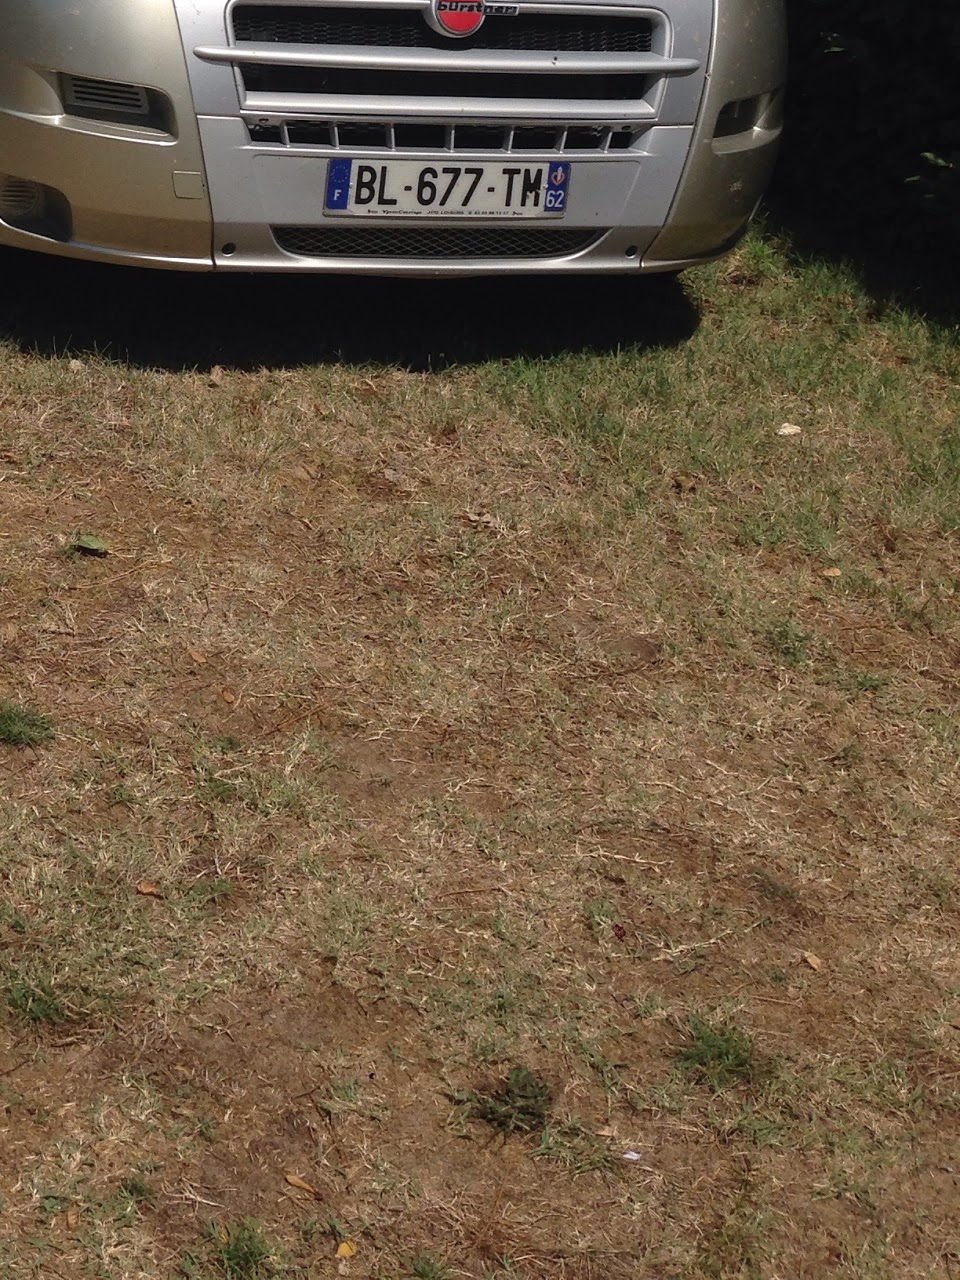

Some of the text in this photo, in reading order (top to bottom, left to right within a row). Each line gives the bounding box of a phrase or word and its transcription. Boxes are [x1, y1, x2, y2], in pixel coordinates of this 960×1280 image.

[333, 189, 342, 201] F
[354, 165, 543, 207] BL-677-TM
[546, 190, 565, 208] 62
